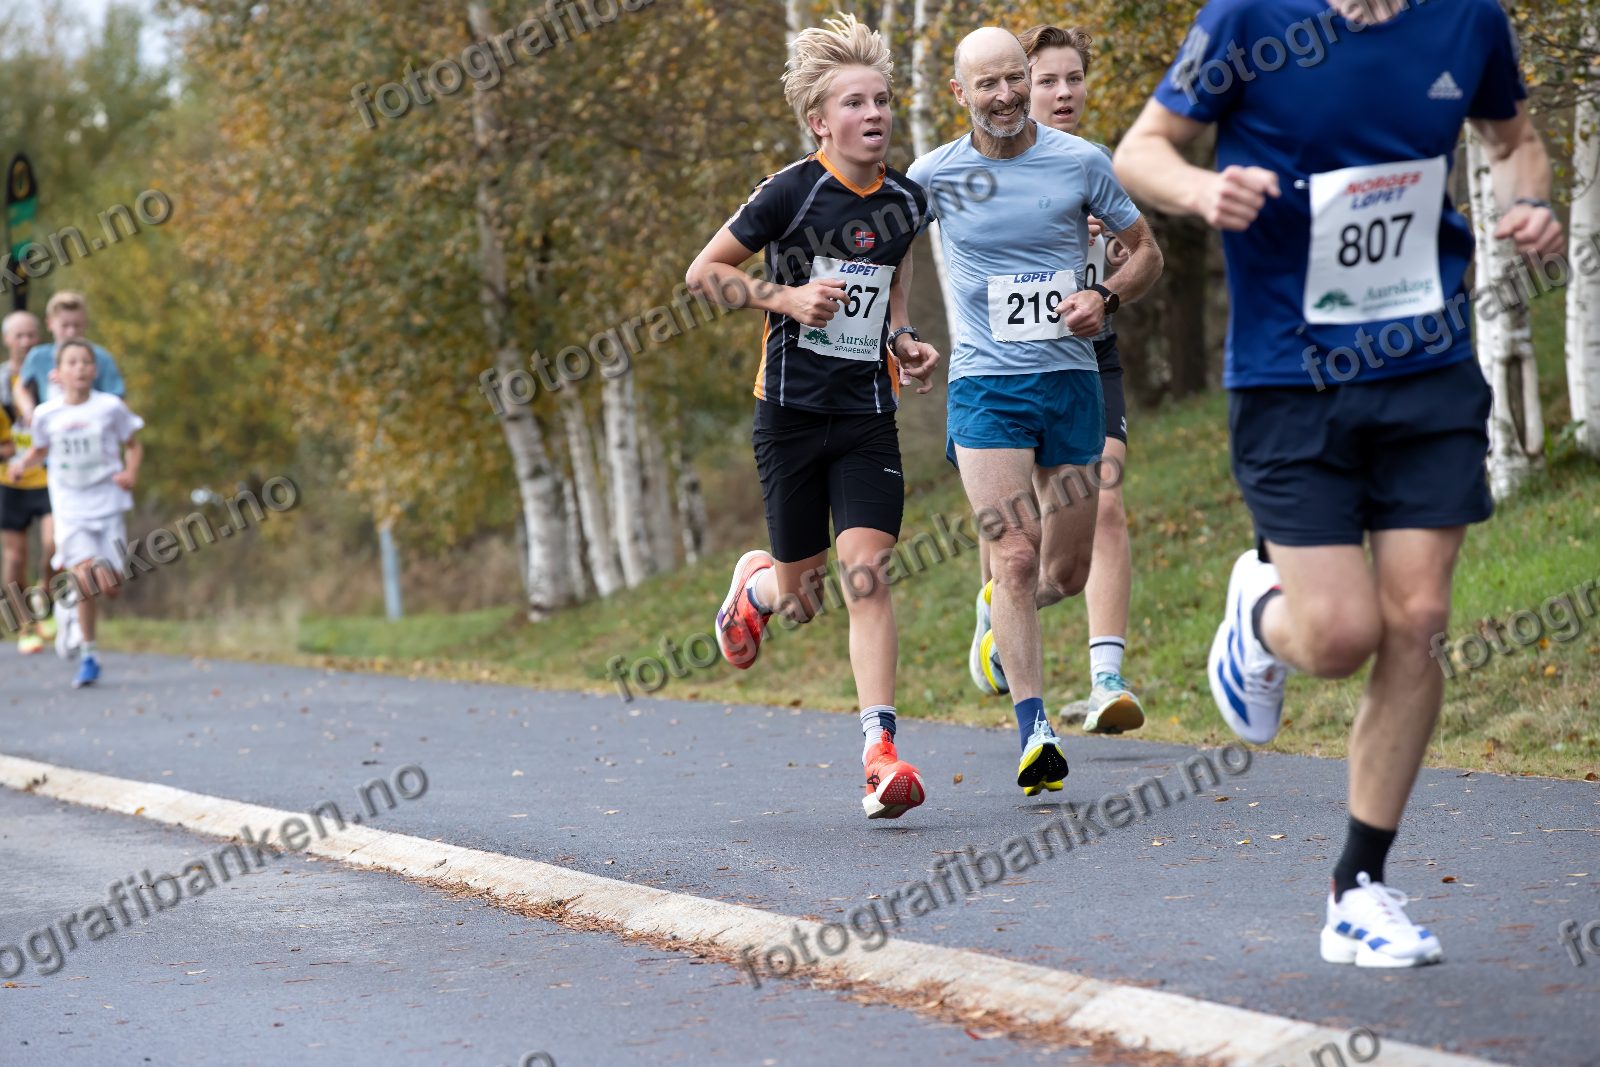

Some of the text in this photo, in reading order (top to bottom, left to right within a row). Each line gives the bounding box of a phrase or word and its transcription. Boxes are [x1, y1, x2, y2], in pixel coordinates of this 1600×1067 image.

[1344, 171, 1422, 195] NORGES
[1351, 187, 1407, 210] LØPET
[1338, 212, 1414, 267] 807
[840, 263, 879, 276] LØPET
[1014, 271, 1056, 283] LØPET
[840, 284, 880, 318] 67
[1007, 290, 1063, 324] 219
[834, 345, 872, 355] SPAREBANK
[836, 333, 879, 349] Aurskog
